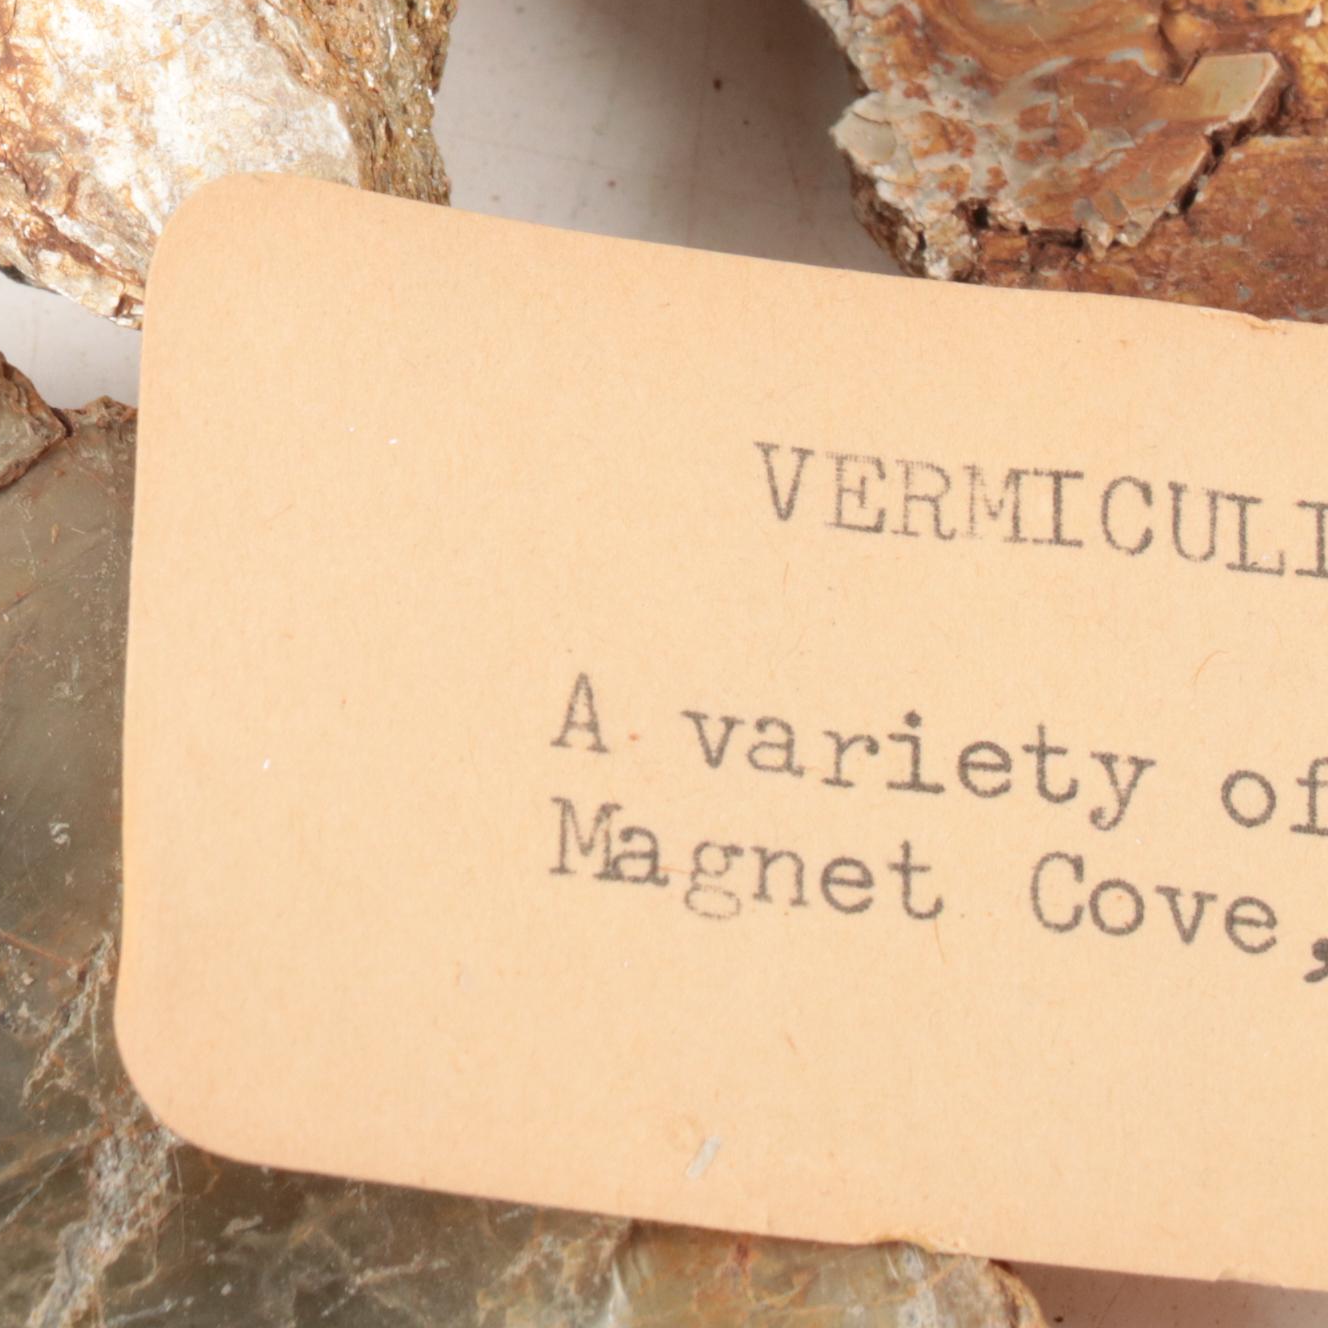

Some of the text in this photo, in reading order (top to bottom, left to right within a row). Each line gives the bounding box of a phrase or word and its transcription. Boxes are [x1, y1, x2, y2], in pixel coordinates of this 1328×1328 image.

[550, 672, 1328, 836] A variety of
[548, 796, 1328, 984] Magnet Cove,
